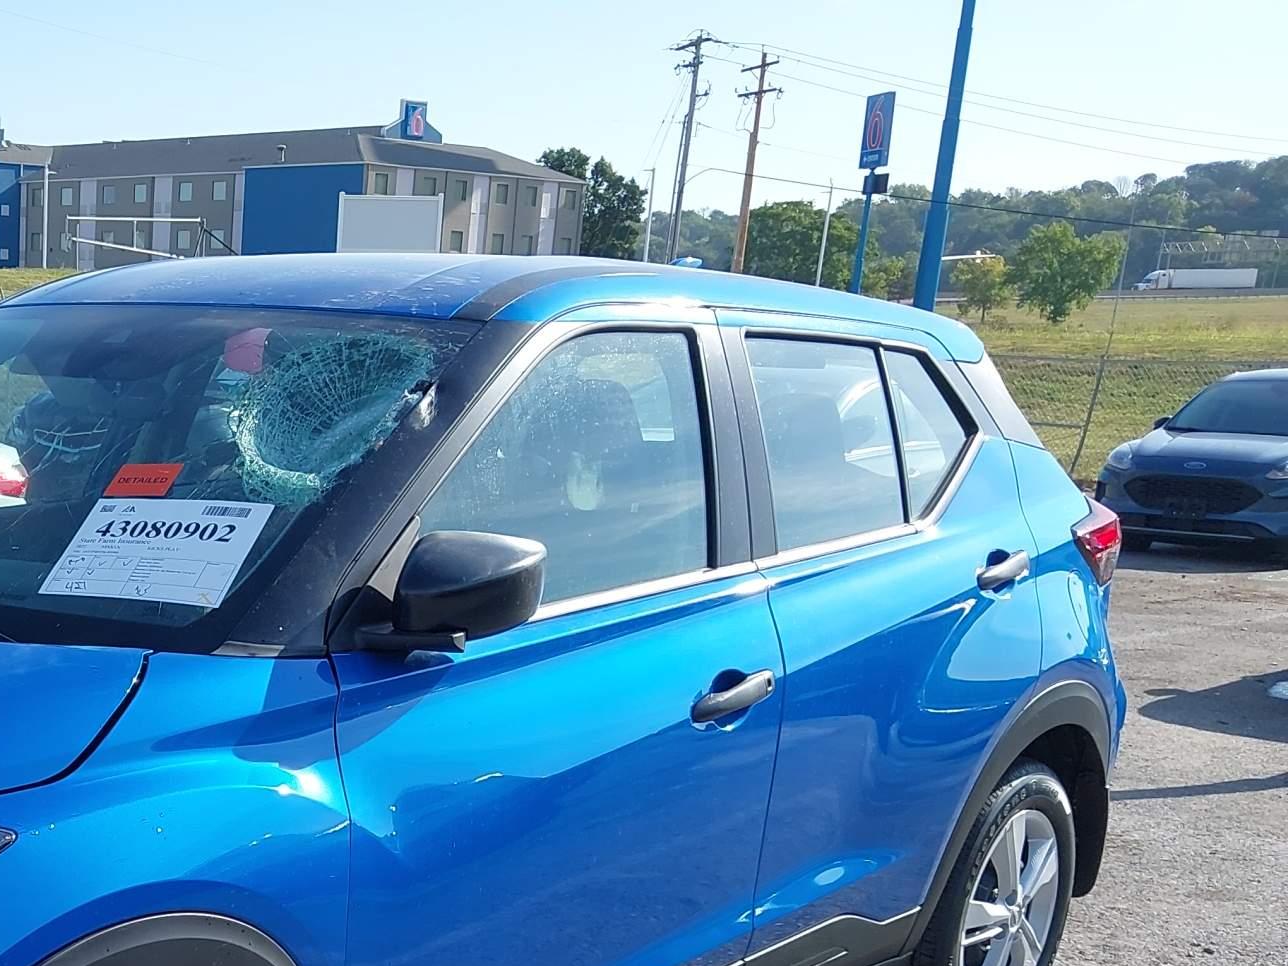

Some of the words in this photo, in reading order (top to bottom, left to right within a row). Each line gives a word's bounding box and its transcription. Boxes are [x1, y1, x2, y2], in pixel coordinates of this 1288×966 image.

[411, 107, 424, 137] 6
[867, 95, 884, 150] 6
[117, 476, 169, 484] DETAILED
[95, 519, 237, 543] 43080902
